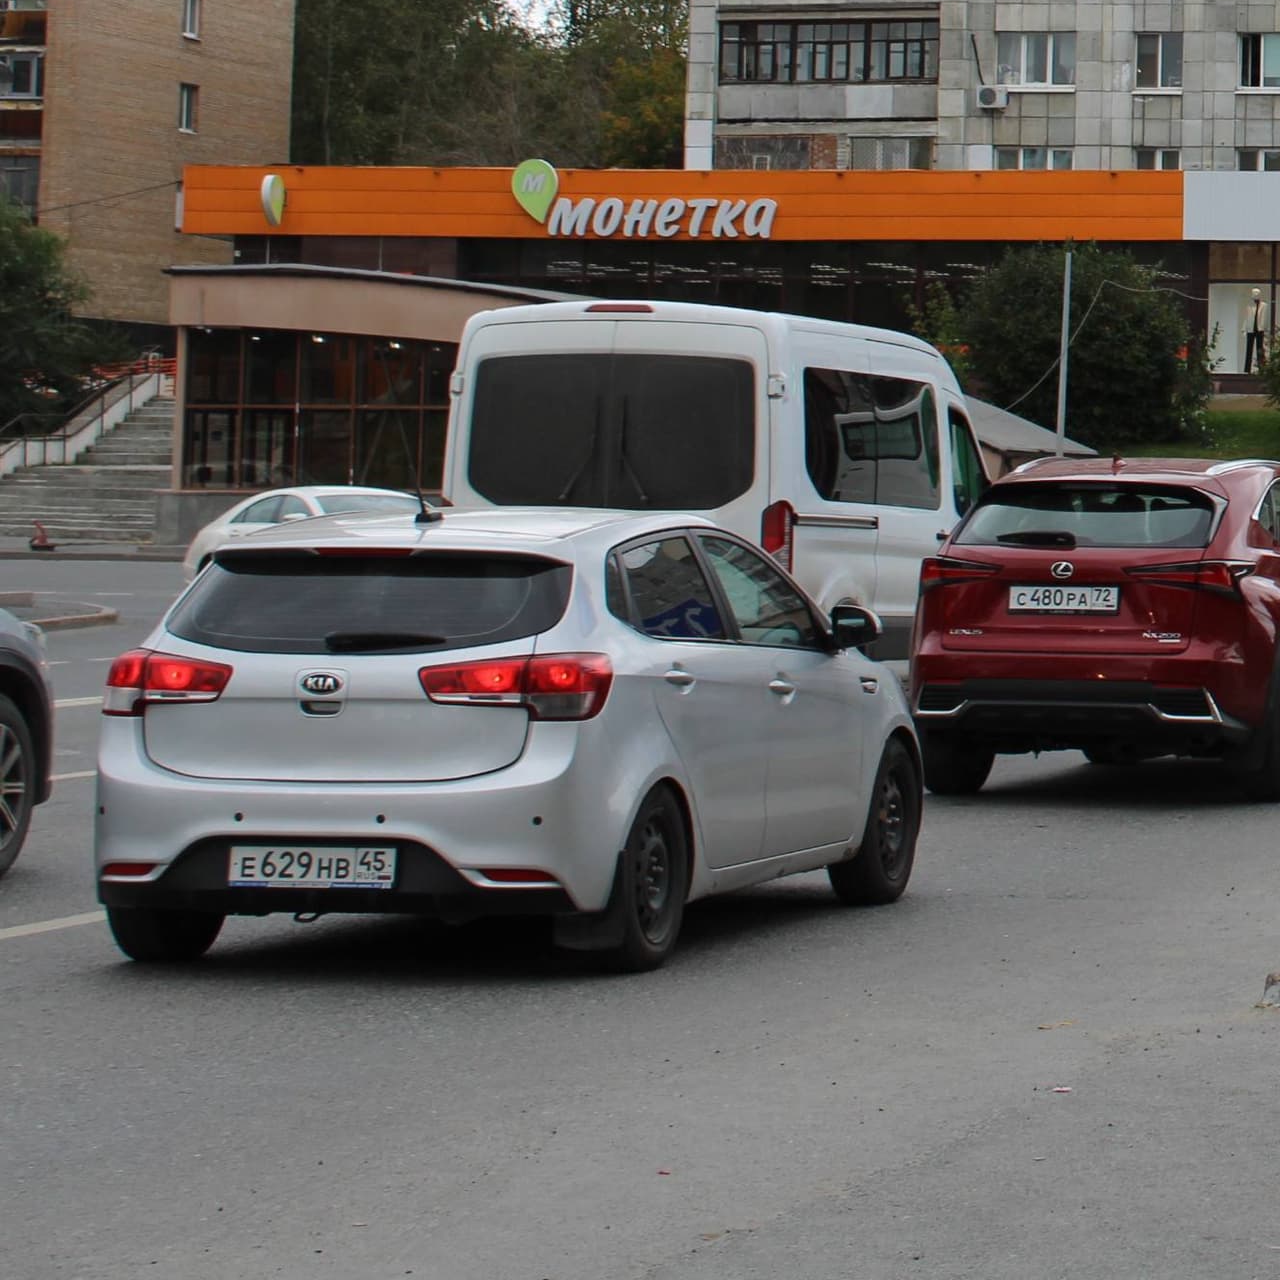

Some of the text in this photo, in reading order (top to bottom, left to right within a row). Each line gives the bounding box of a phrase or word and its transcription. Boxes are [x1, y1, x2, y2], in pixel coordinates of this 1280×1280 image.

[1094, 588, 1111, 602] 72
[305, 676, 337, 690] KIA
[359, 850, 386, 872] 45
